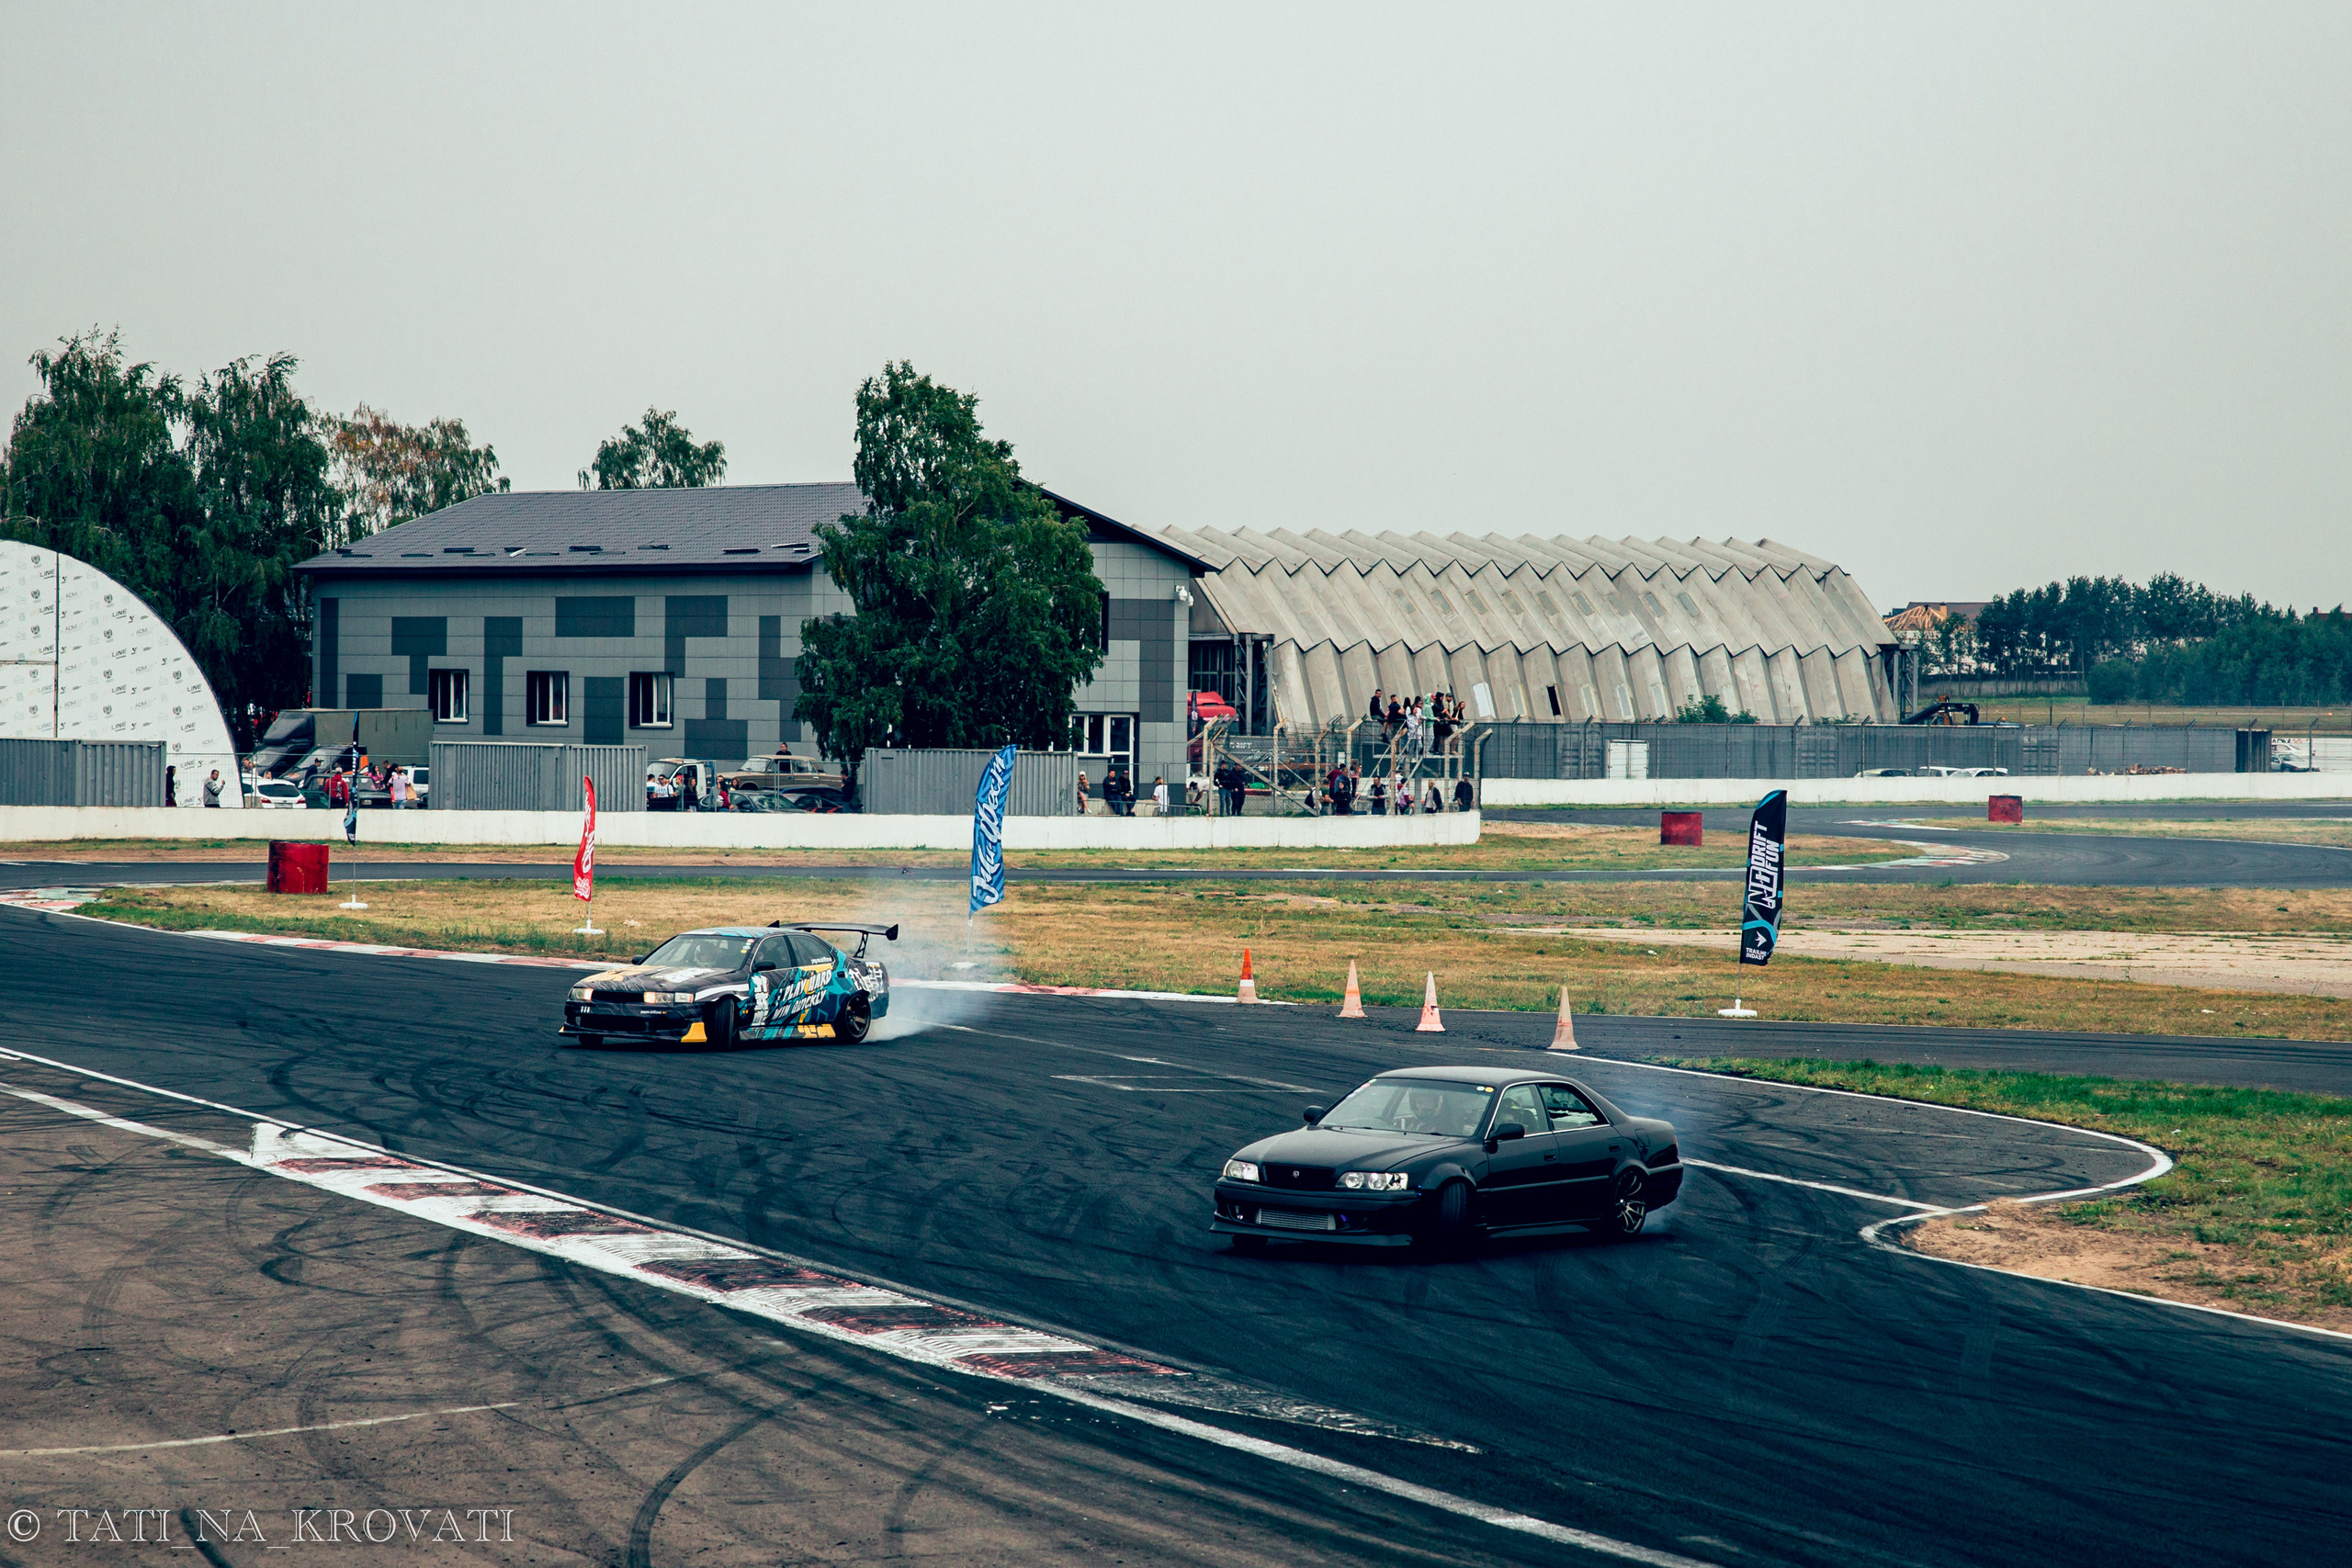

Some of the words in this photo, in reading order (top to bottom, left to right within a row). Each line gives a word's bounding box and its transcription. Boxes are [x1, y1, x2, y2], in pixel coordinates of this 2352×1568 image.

[1750, 820, 1768, 868] DRIFT
[1765, 839, 1781, 873] FUN
[782, 979, 808, 1002] PLAY
[808, 969, 832, 992] HARD
[772, 1003, 792, 1021] WIN
[791, 988, 827, 1014] QUICKLY
